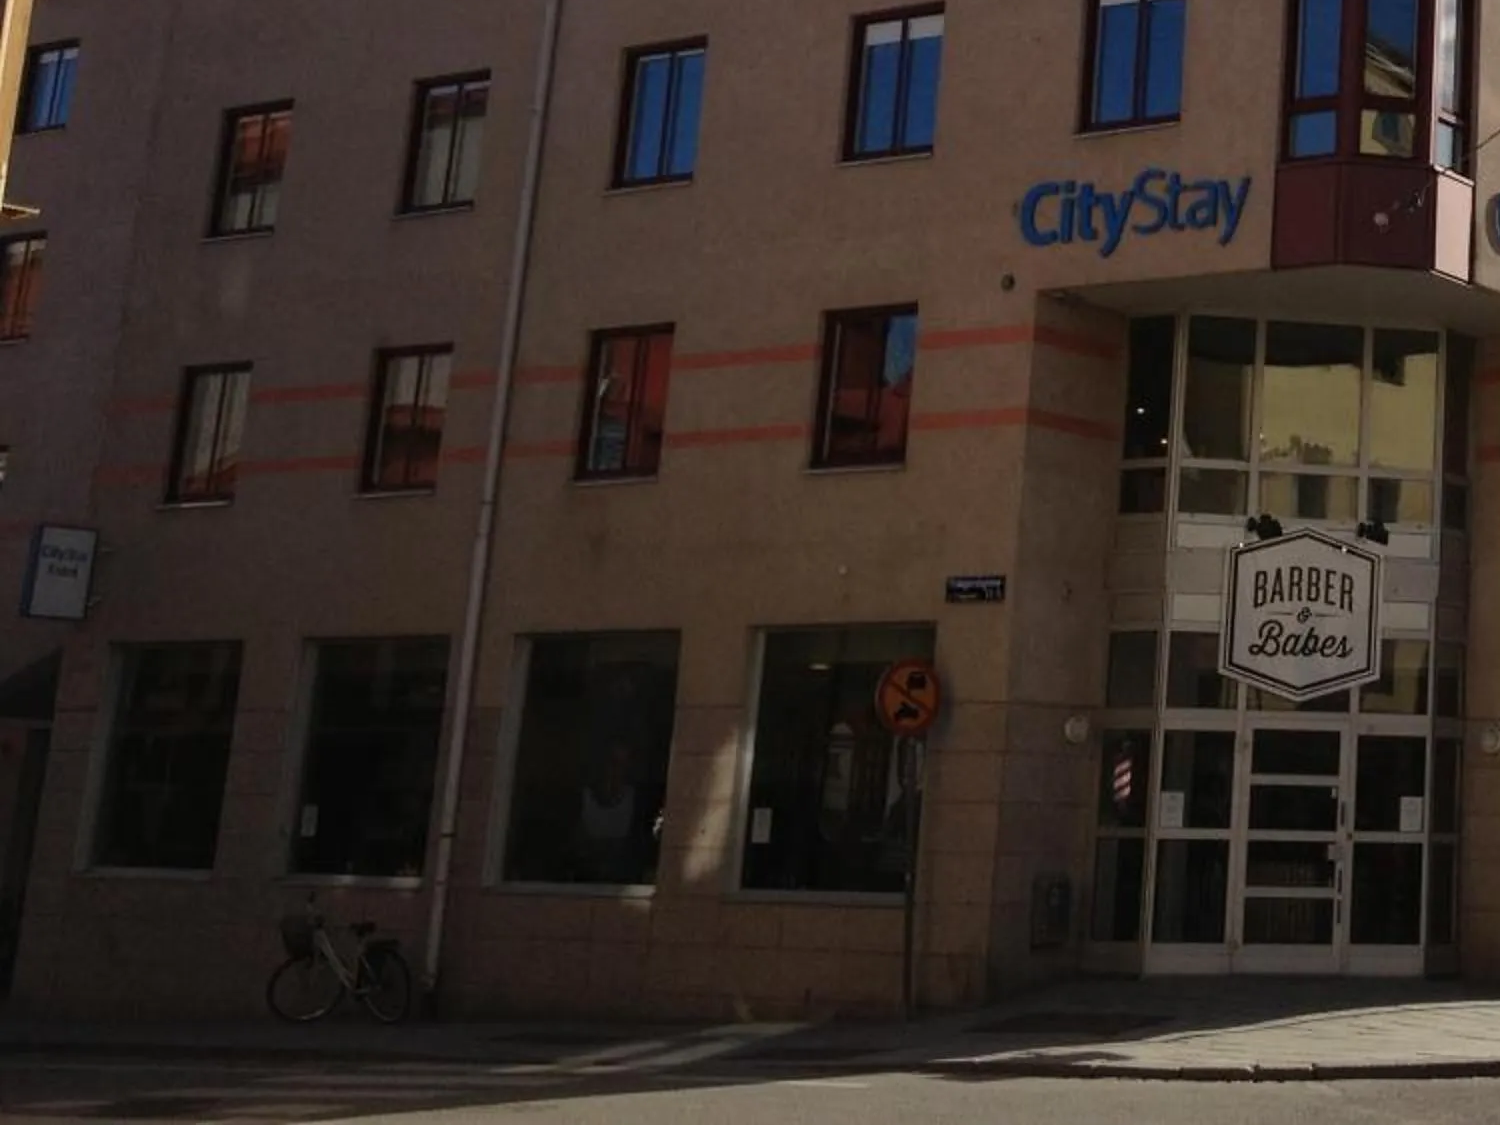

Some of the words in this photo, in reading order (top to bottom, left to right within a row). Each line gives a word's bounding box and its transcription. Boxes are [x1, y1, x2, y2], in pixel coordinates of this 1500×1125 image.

[1020, 167, 1252, 260] CityStay
[1253, 566, 1355, 614] BARBER
[1297, 606, 1313, 624] &
[1248, 619, 1353, 659] Babes
